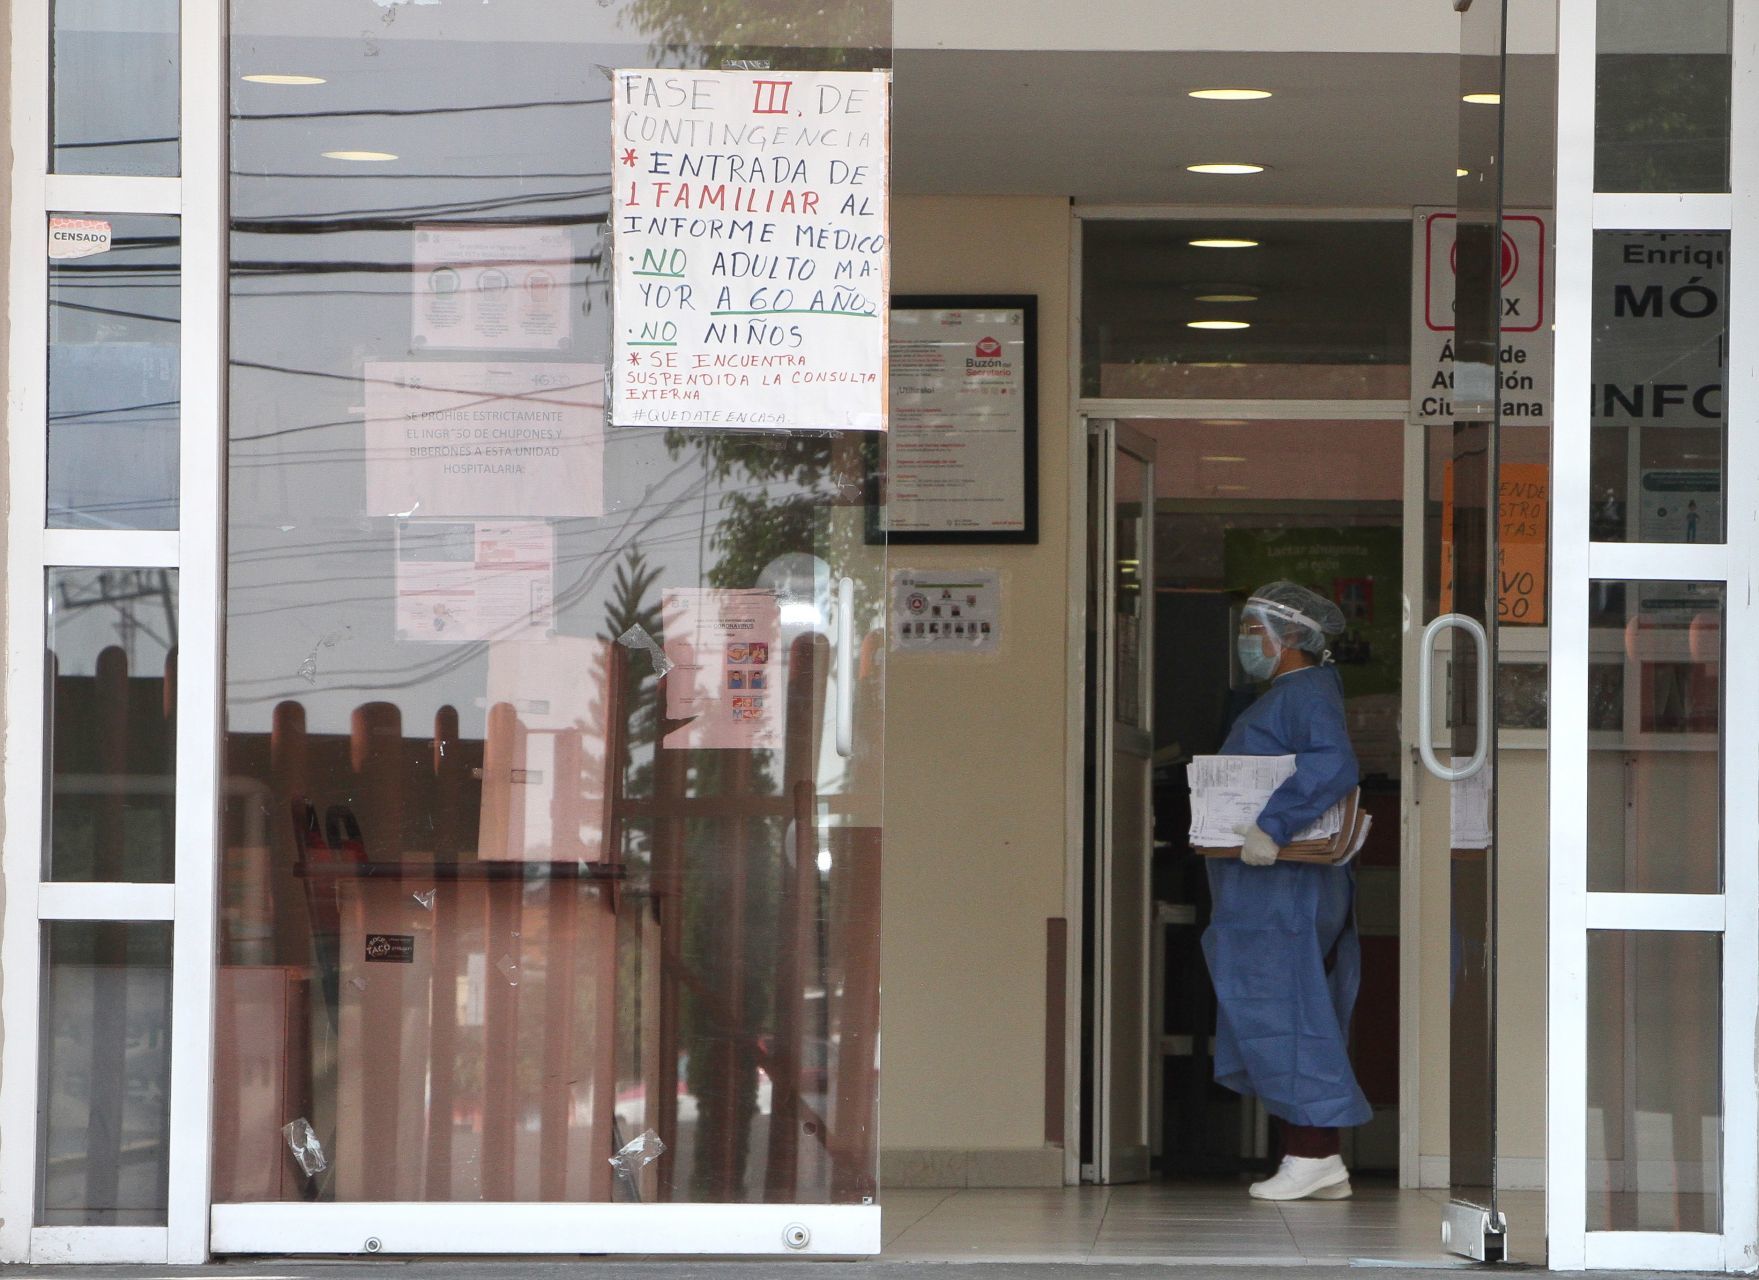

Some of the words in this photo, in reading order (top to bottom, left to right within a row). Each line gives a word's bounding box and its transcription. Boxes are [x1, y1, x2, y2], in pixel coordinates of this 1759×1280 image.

[620, 75, 720, 109] FASE
[816, 84, 869, 115] DE
[624, 111, 870, 151] CONTINGENCIA
[648, 151, 808, 184] ENTRADA
[829, 159, 869, 185] DE
[652, 182, 820, 215] FAMILIAR
[840, 193, 875, 217] AL
[53, 231, 107, 243] CENSADO
[623, 216, 776, 243] INFORME
[796, 222, 885, 254] MÉDICO
[641, 248, 687, 275] NO
[712, 251, 816, 281] ADULTO
[834, 259, 879, 280] MA-
[639, 283, 696, 311] YOR
[717, 286, 731, 311] A
[749, 286, 794, 312] 60
[810, 284, 877, 314] AÑOS
[1613, 276, 1719, 319] MÓ
[640, 320, 678, 342] NO
[704, 318, 803, 348] NIÑOS
[650, 351, 678, 368] SE
[692, 353, 806, 369] ENCUENTRA
[965, 357, 1002, 368] Buzón
[1500, 345, 1527, 364] de
[626, 371, 750, 386] SUSPENDIDA
[762, 373, 782, 386] LA
[792, 371, 877, 384] CONSULTA
[626, 388, 701, 401] EXTERNA
[406, 412, 418, 421] SE
[421, 411, 470, 421] PROHIBE
[473, 411, 563, 422] ESTRICTAMENTE
[633, 408, 720, 423] #QUEDATE
[407, 429, 418, 439] EL
[474, 429, 489, 439] DE
[492, 429, 553, 439] CHUPONES
[555, 429, 562, 439] Y
[409, 447, 472, 457] BIBERONES
[474, 447, 482, 457] A
[485, 447, 513, 457] ESTA
[515, 447, 560, 457] UNIDAD
[366, 944, 391, 955] TACO
